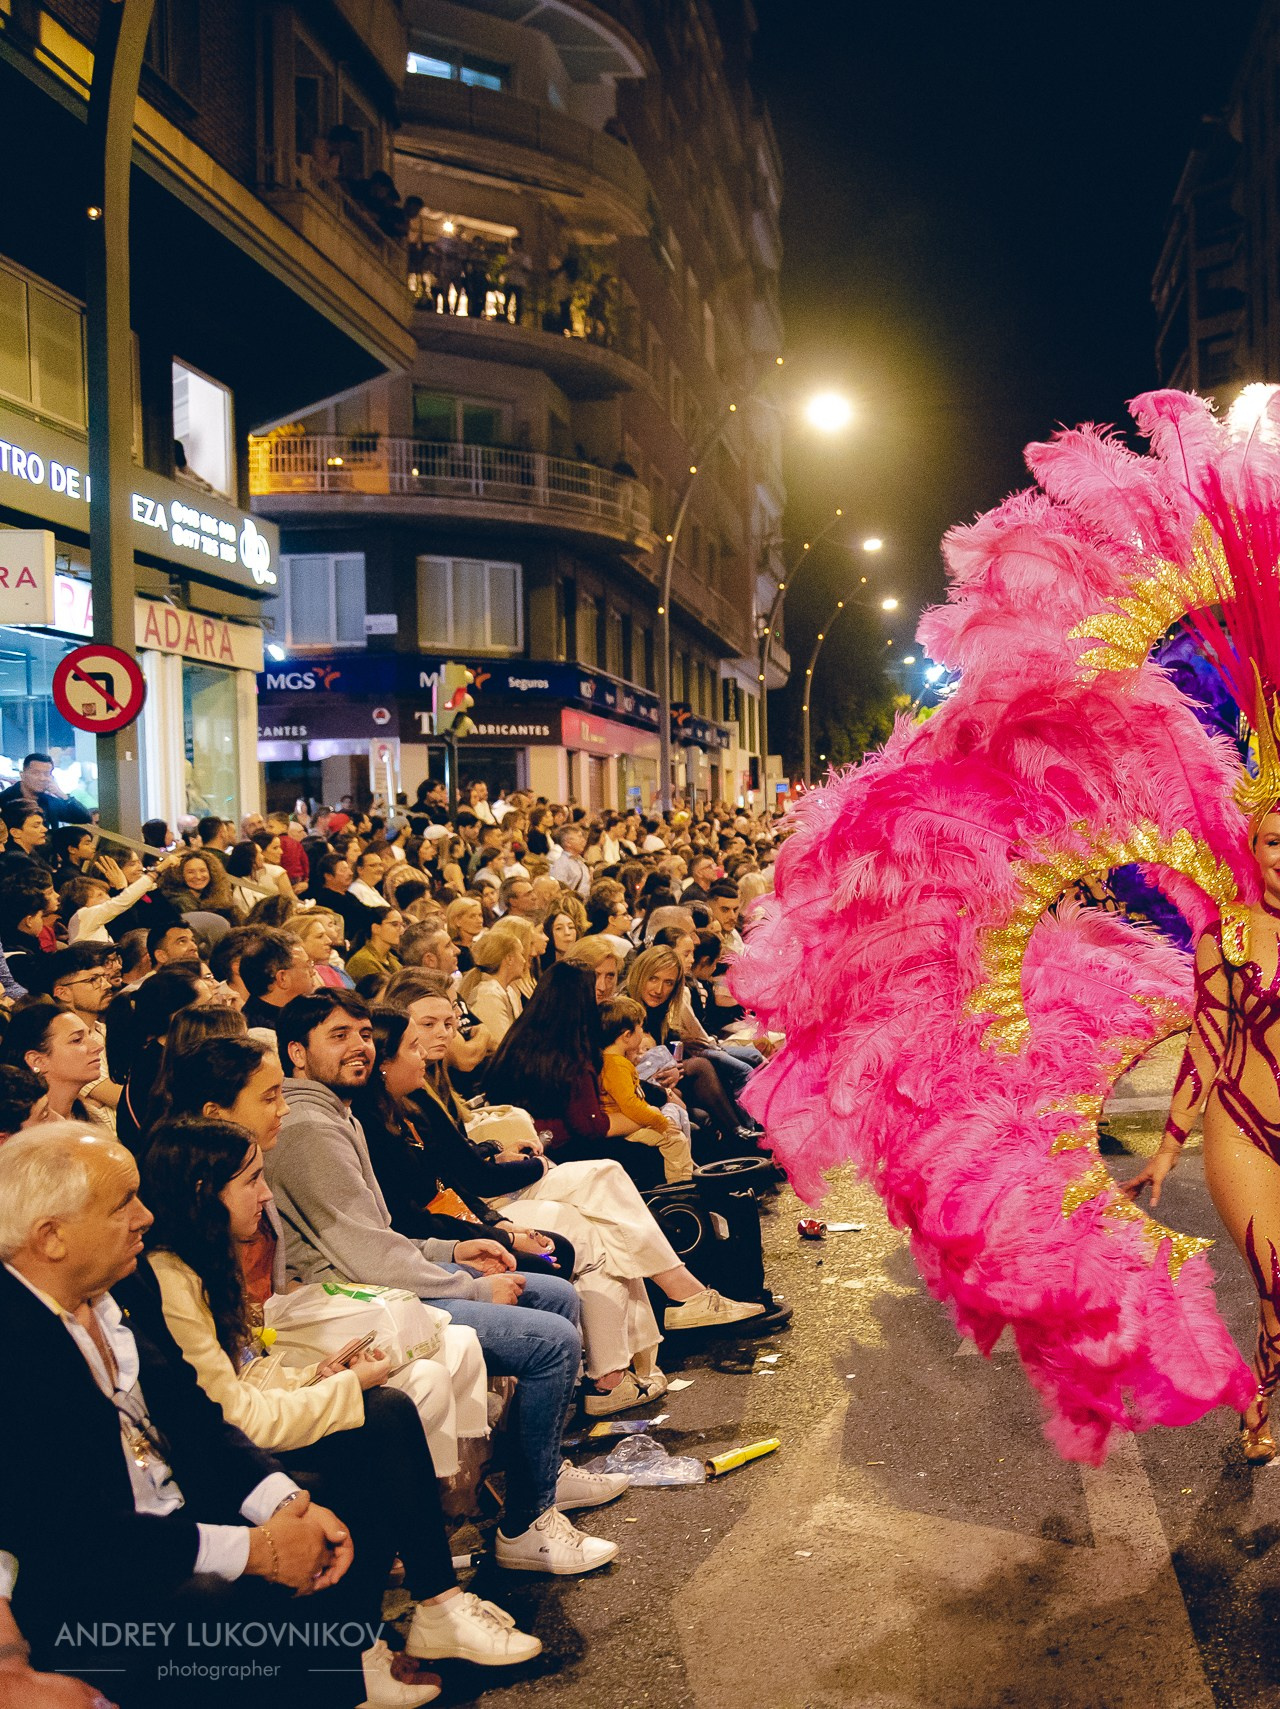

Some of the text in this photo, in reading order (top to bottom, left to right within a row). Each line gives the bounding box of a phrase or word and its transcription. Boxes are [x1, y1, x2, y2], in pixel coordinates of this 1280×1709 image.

[50, 460, 81, 499] DE
[144, 604, 235, 662] ADARA
[266, 671, 317, 691] MGS
[507, 676, 549, 691] Seguros
